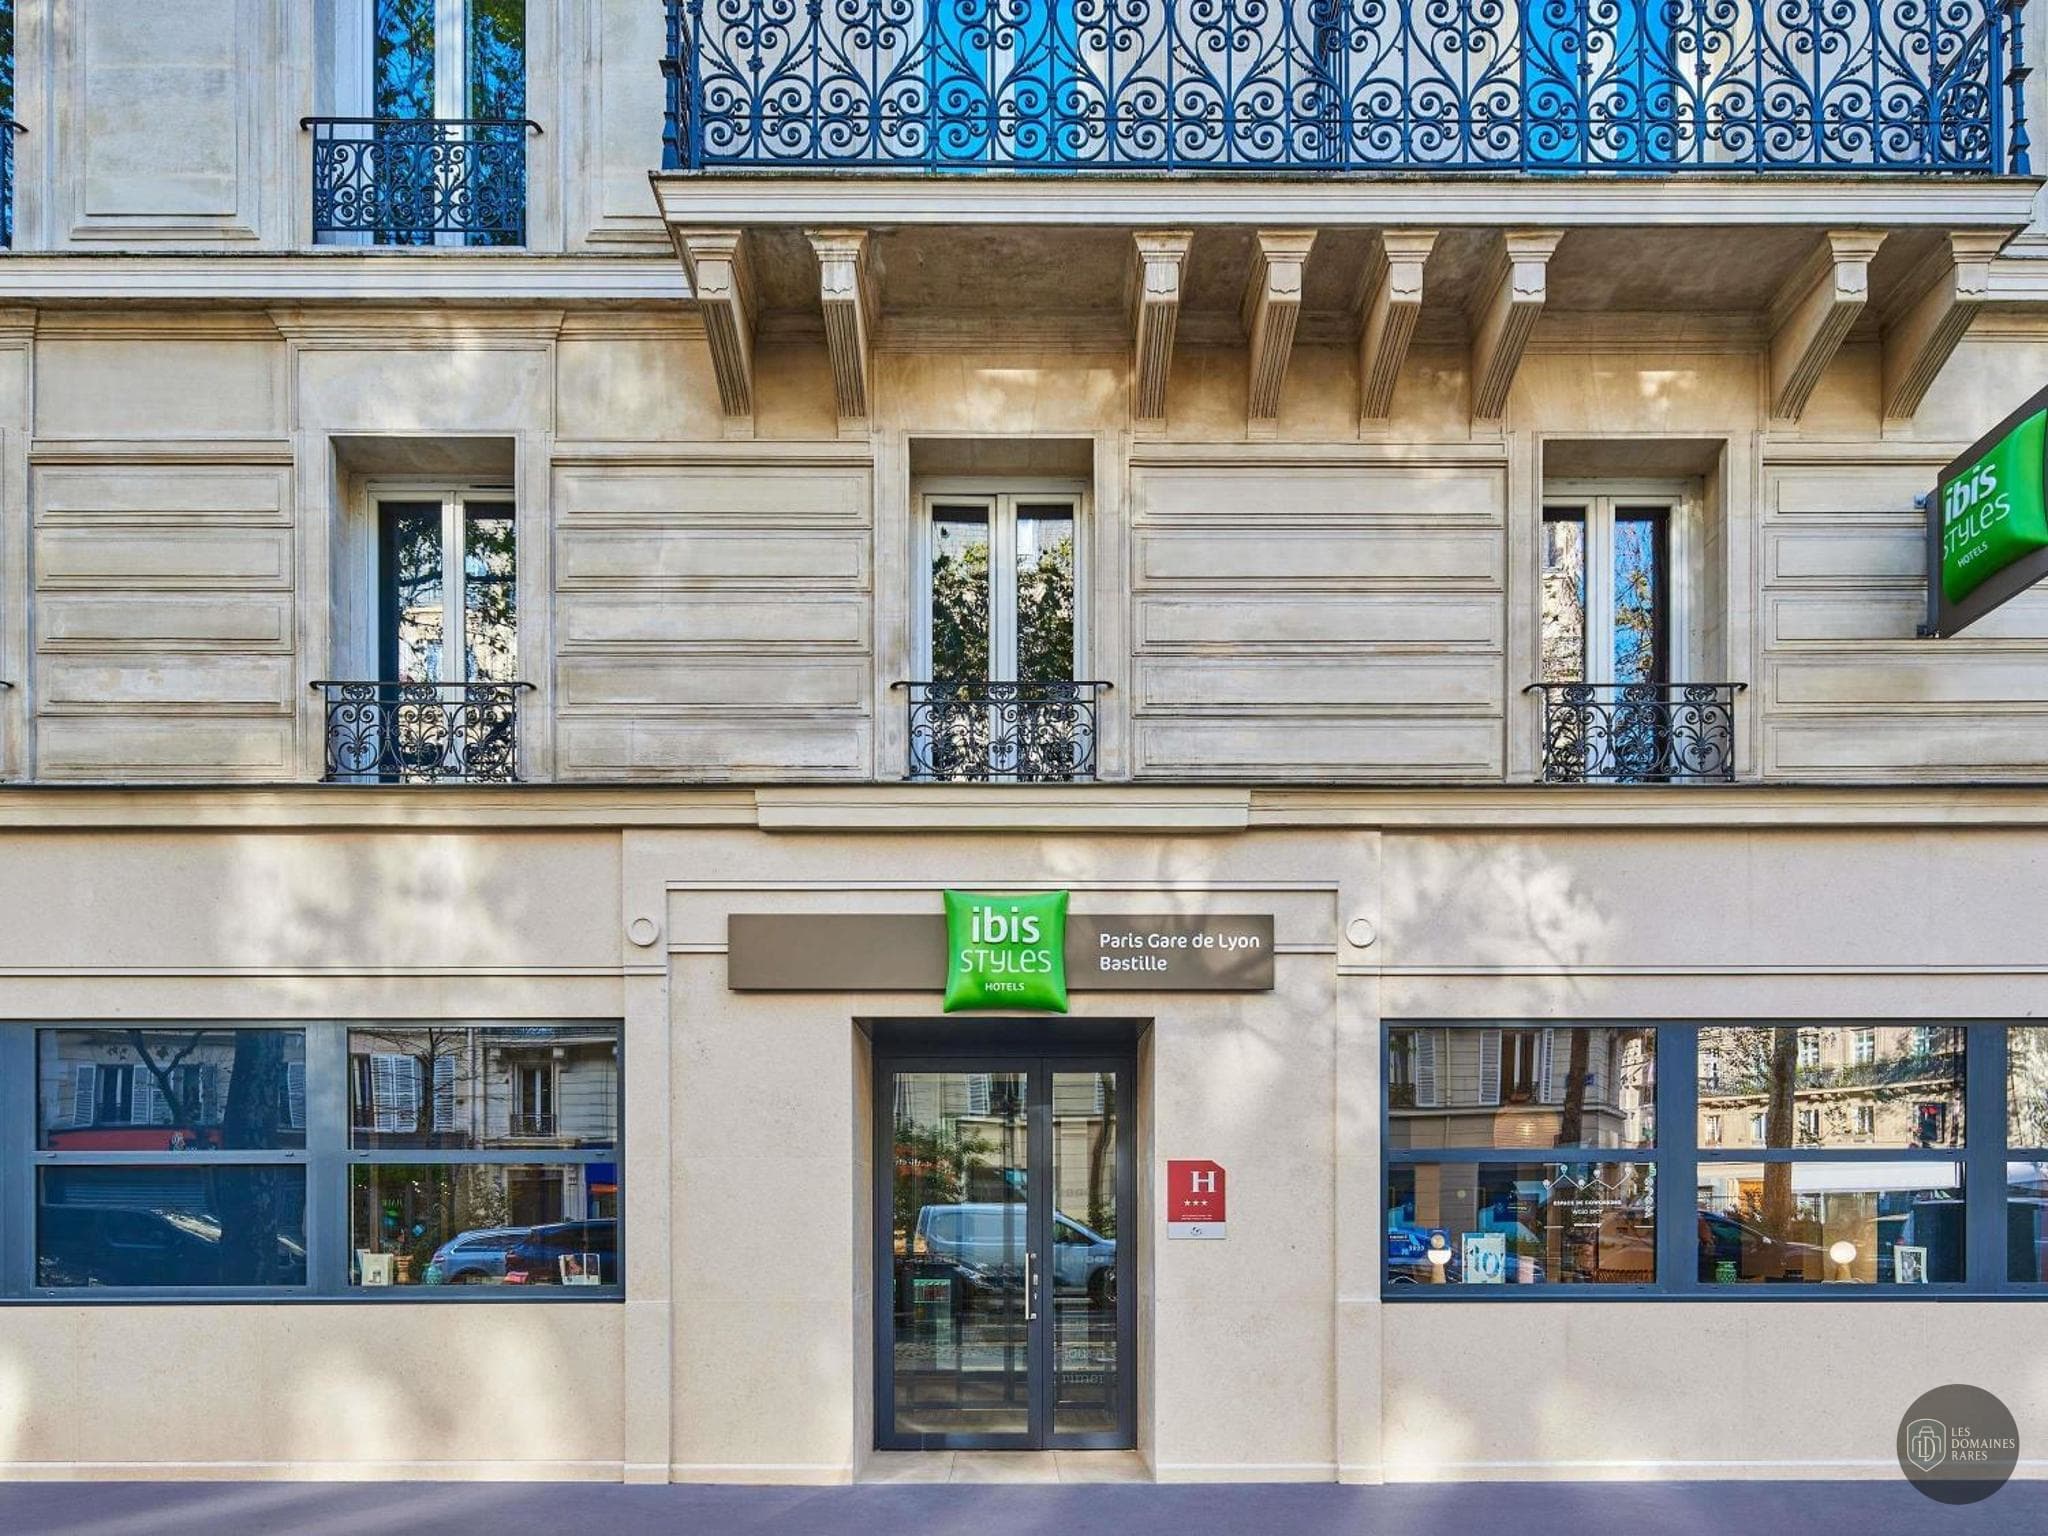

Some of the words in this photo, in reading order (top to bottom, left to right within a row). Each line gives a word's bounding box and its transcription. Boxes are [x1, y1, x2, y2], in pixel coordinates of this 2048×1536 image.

[1945, 464, 1996, 526] ibis
[1958, 541, 1988, 567] HOTELS
[972, 906, 1041, 943] ibis
[1100, 933, 1144, 948] Paris
[1148, 933, 1188, 948] Gare
[1192, 933, 1215, 948] de
[1218, 933, 1260, 951] Lyon
[1100, 956, 1168, 971] Bastille
[985, 982, 1025, 992] HOTELS
[1190, 1170, 1217, 1193] H
